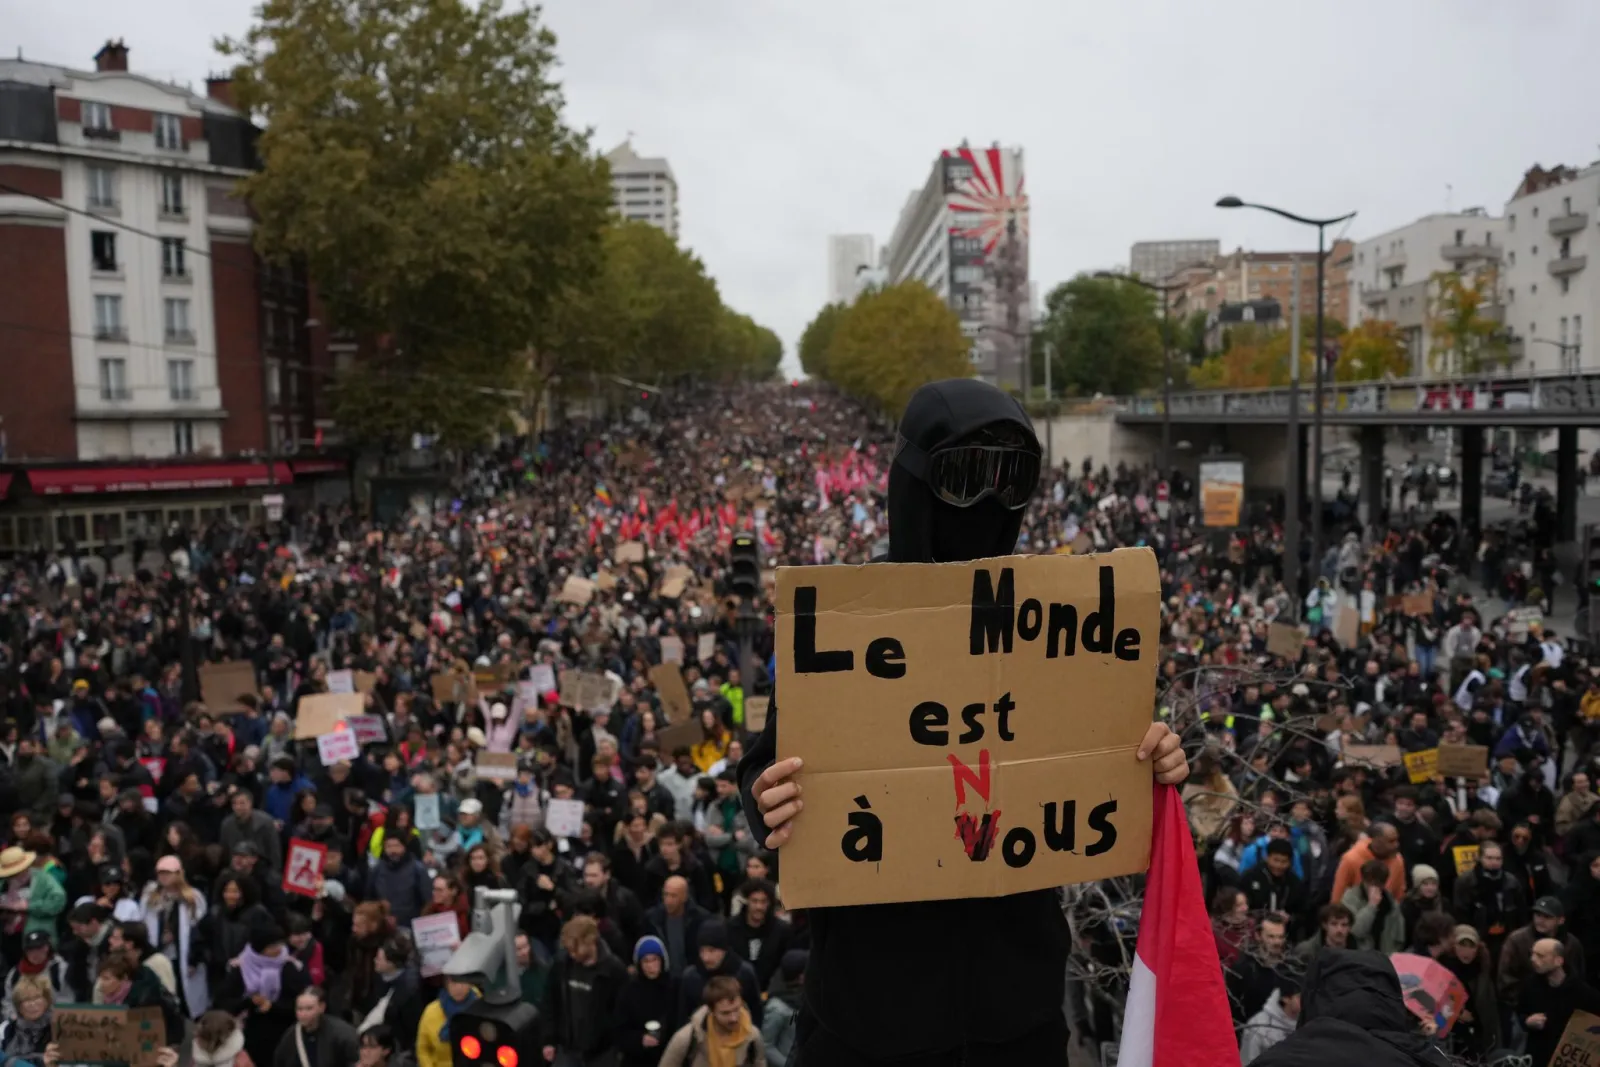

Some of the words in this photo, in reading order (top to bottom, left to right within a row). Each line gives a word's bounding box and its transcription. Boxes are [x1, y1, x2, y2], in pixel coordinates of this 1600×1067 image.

[793, 585, 907, 680] Le
[969, 565, 1141, 662] Monde
[908, 691, 1016, 747] est
[946, 748, 991, 808] N
[841, 794, 883, 863] à
